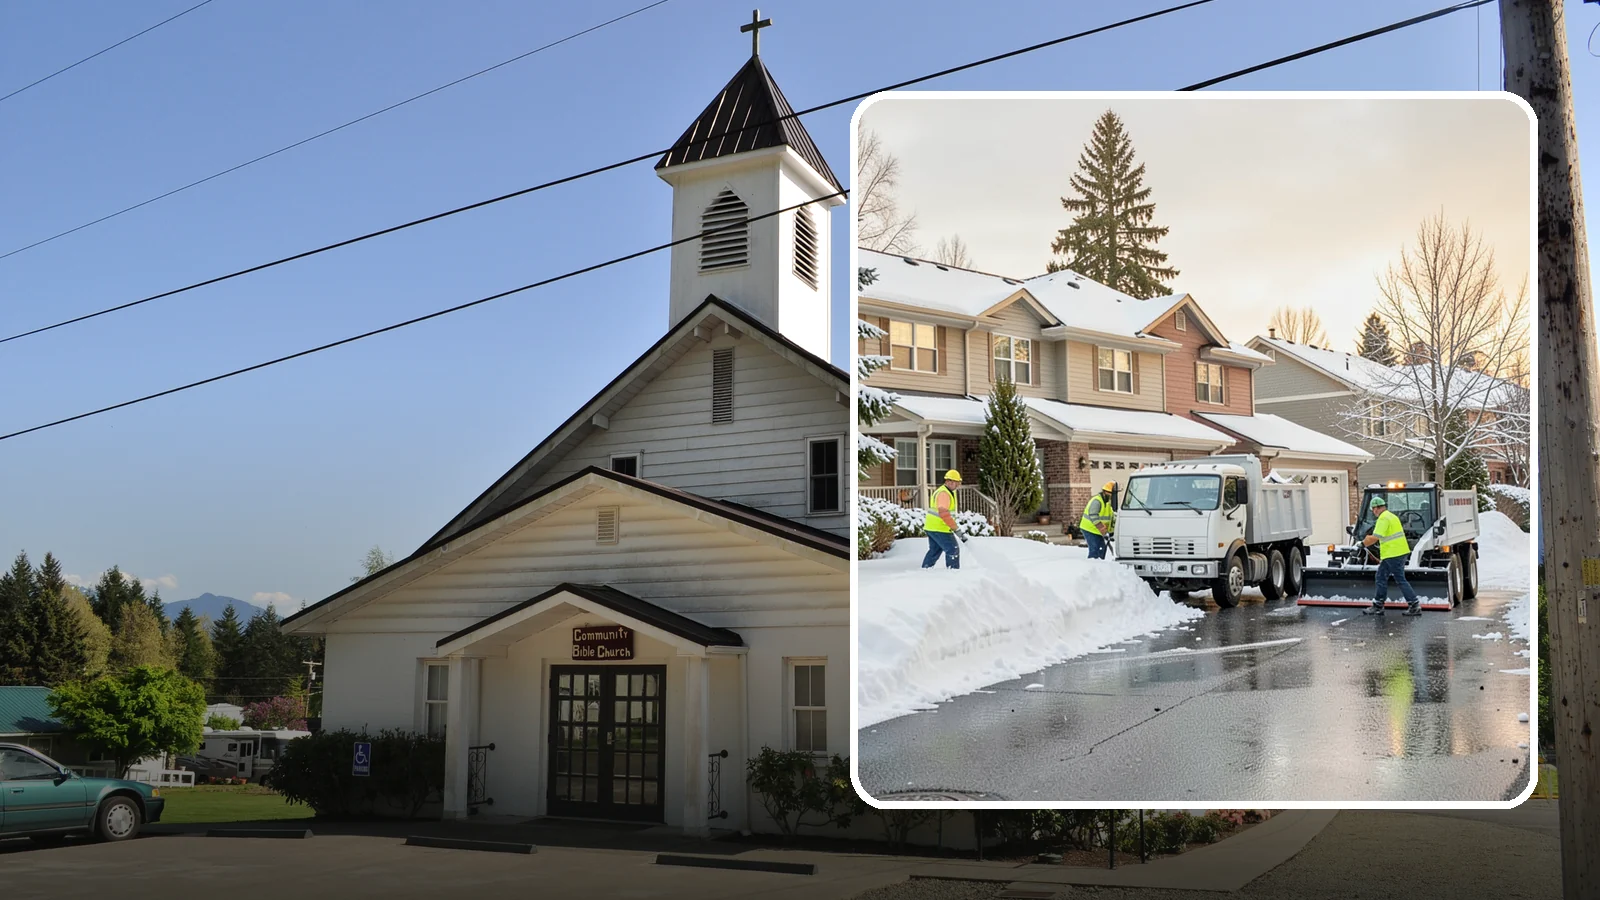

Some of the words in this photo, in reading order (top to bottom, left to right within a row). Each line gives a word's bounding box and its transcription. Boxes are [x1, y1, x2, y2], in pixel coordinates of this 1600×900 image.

[574, 627, 628, 641] Community
[572, 645, 595, 657] Bible
[597, 645, 631, 658] Church
